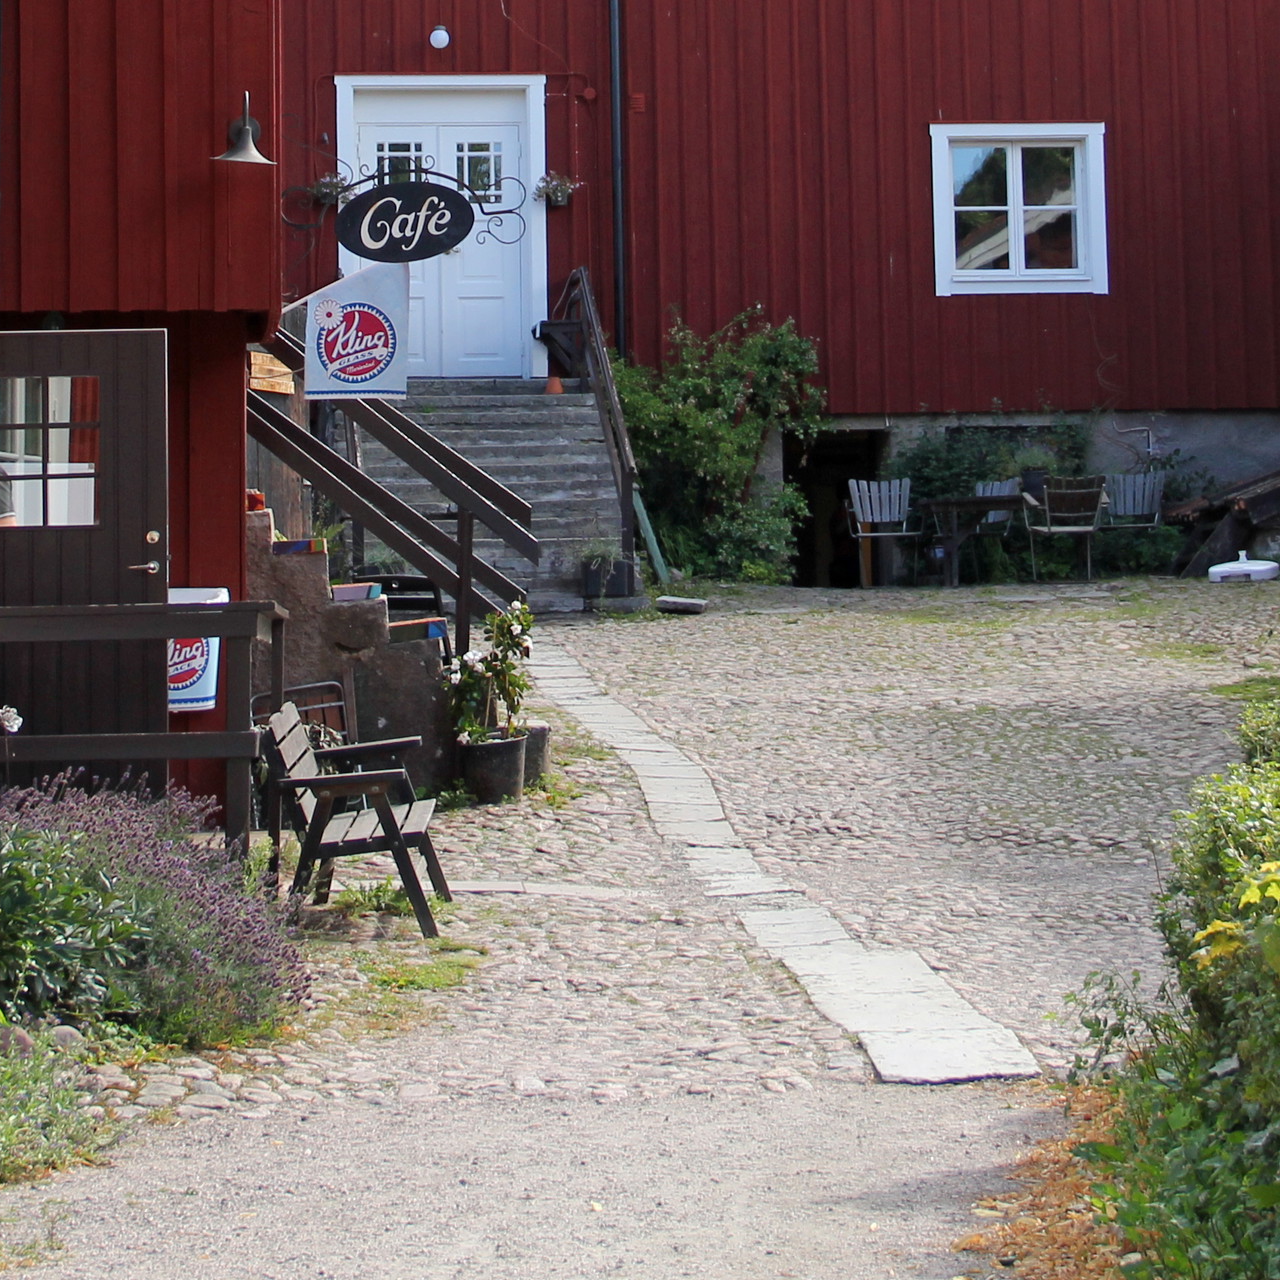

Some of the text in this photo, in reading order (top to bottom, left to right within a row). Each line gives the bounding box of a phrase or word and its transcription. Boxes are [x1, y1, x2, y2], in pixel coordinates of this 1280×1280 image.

[360, 196, 451, 251] Café
[327, 311, 386, 360] Kling
[338, 351, 374, 366] GLASS
[168, 639, 202, 665] ling
